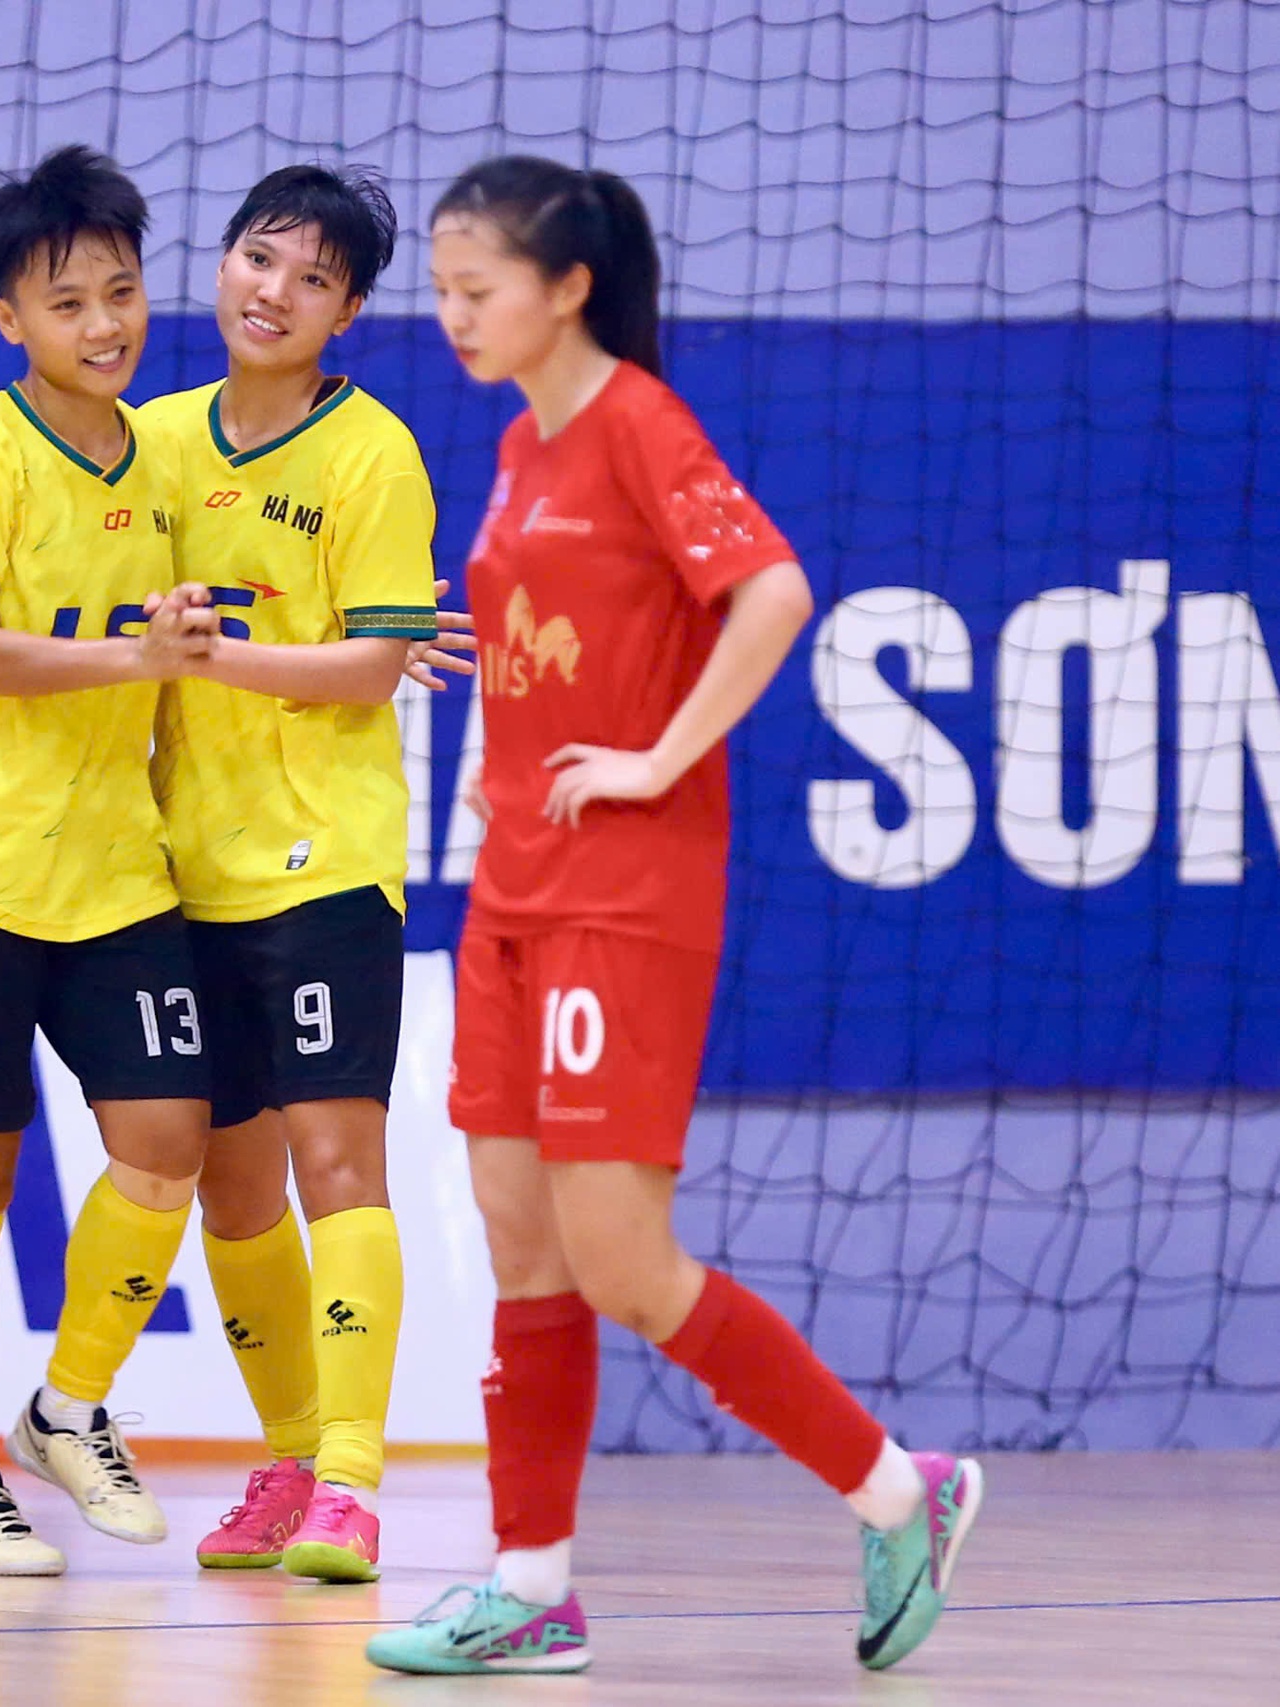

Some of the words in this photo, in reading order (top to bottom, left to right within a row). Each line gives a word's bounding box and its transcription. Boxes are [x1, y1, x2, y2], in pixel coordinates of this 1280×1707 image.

[135, 987, 202, 1057] 13
[293, 982, 334, 1055] 9
[541, 985, 606, 1077] 10
